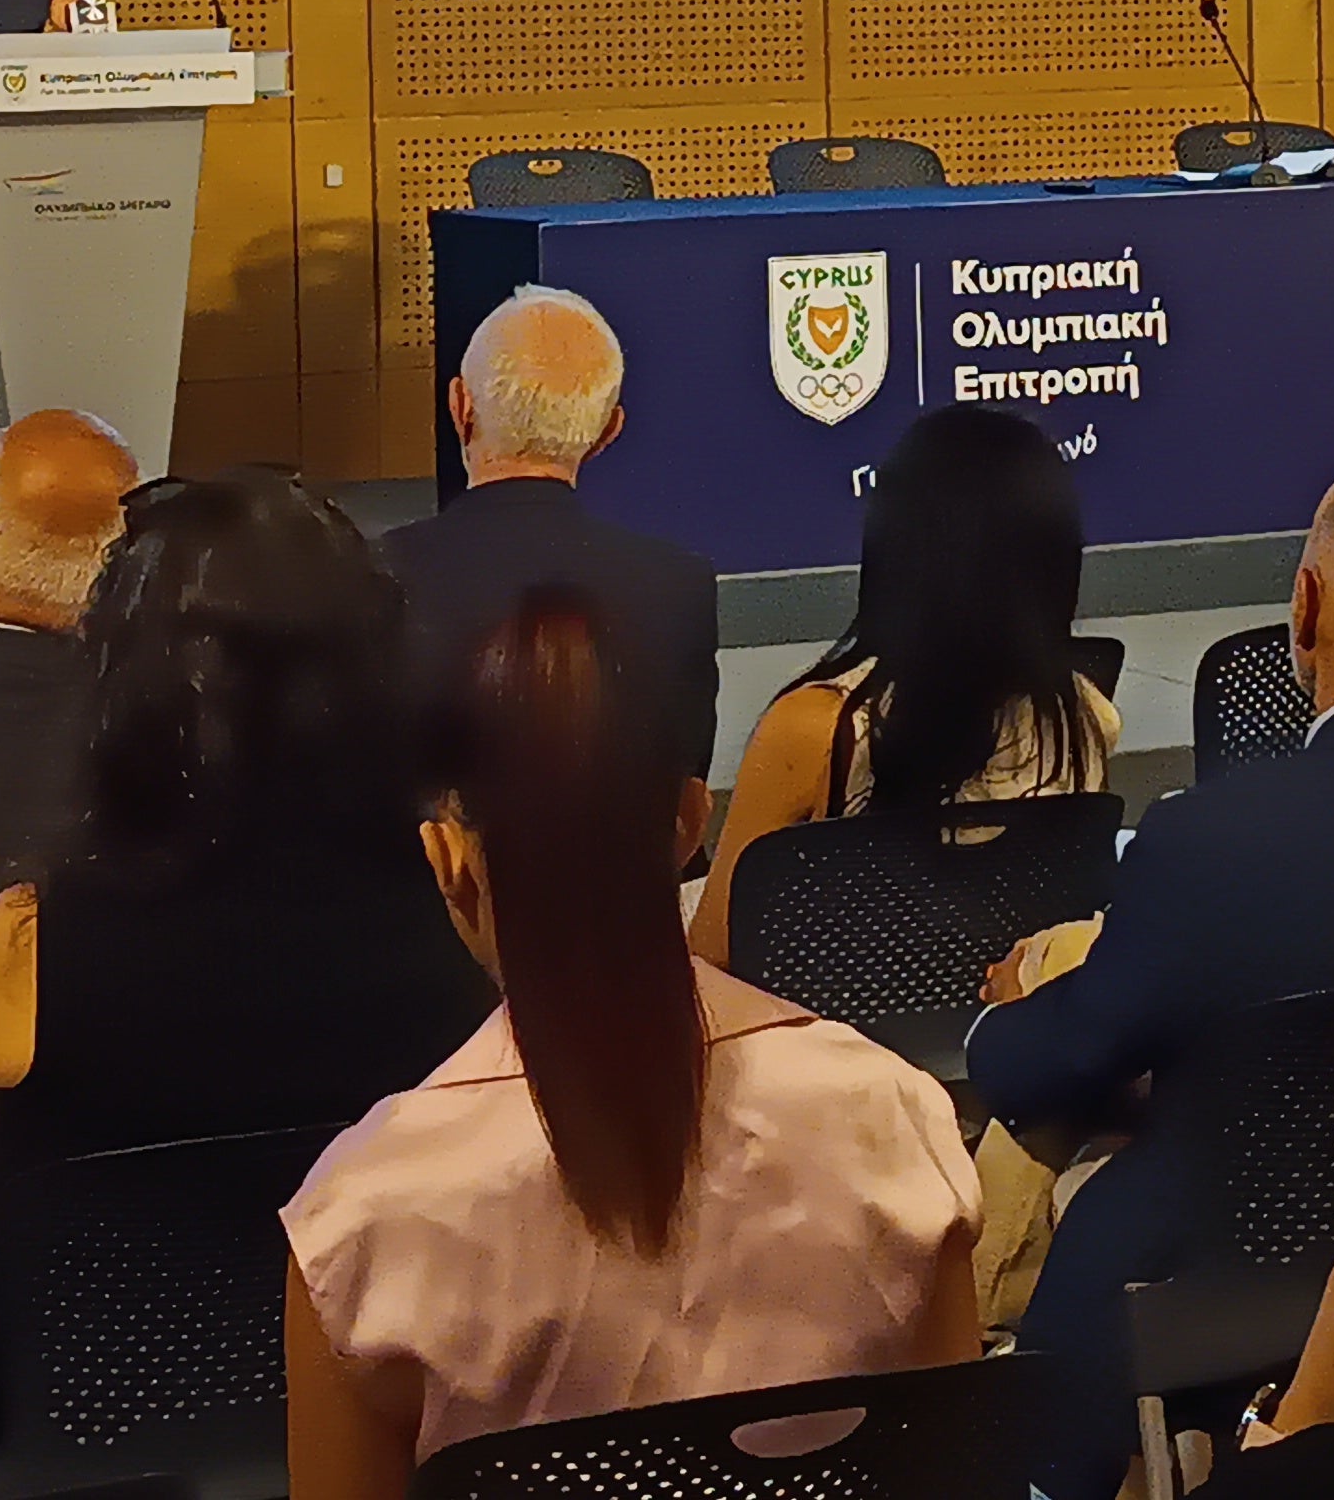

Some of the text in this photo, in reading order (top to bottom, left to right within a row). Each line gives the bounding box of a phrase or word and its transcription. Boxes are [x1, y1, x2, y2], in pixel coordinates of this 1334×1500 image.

[779, 264, 874, 291] CYPRUS
[951, 246, 1140, 299] Κυπριακή
[952, 297, 1168, 353] Ολυμπιακή
[954, 352, 1140, 404] Επιτροπή
